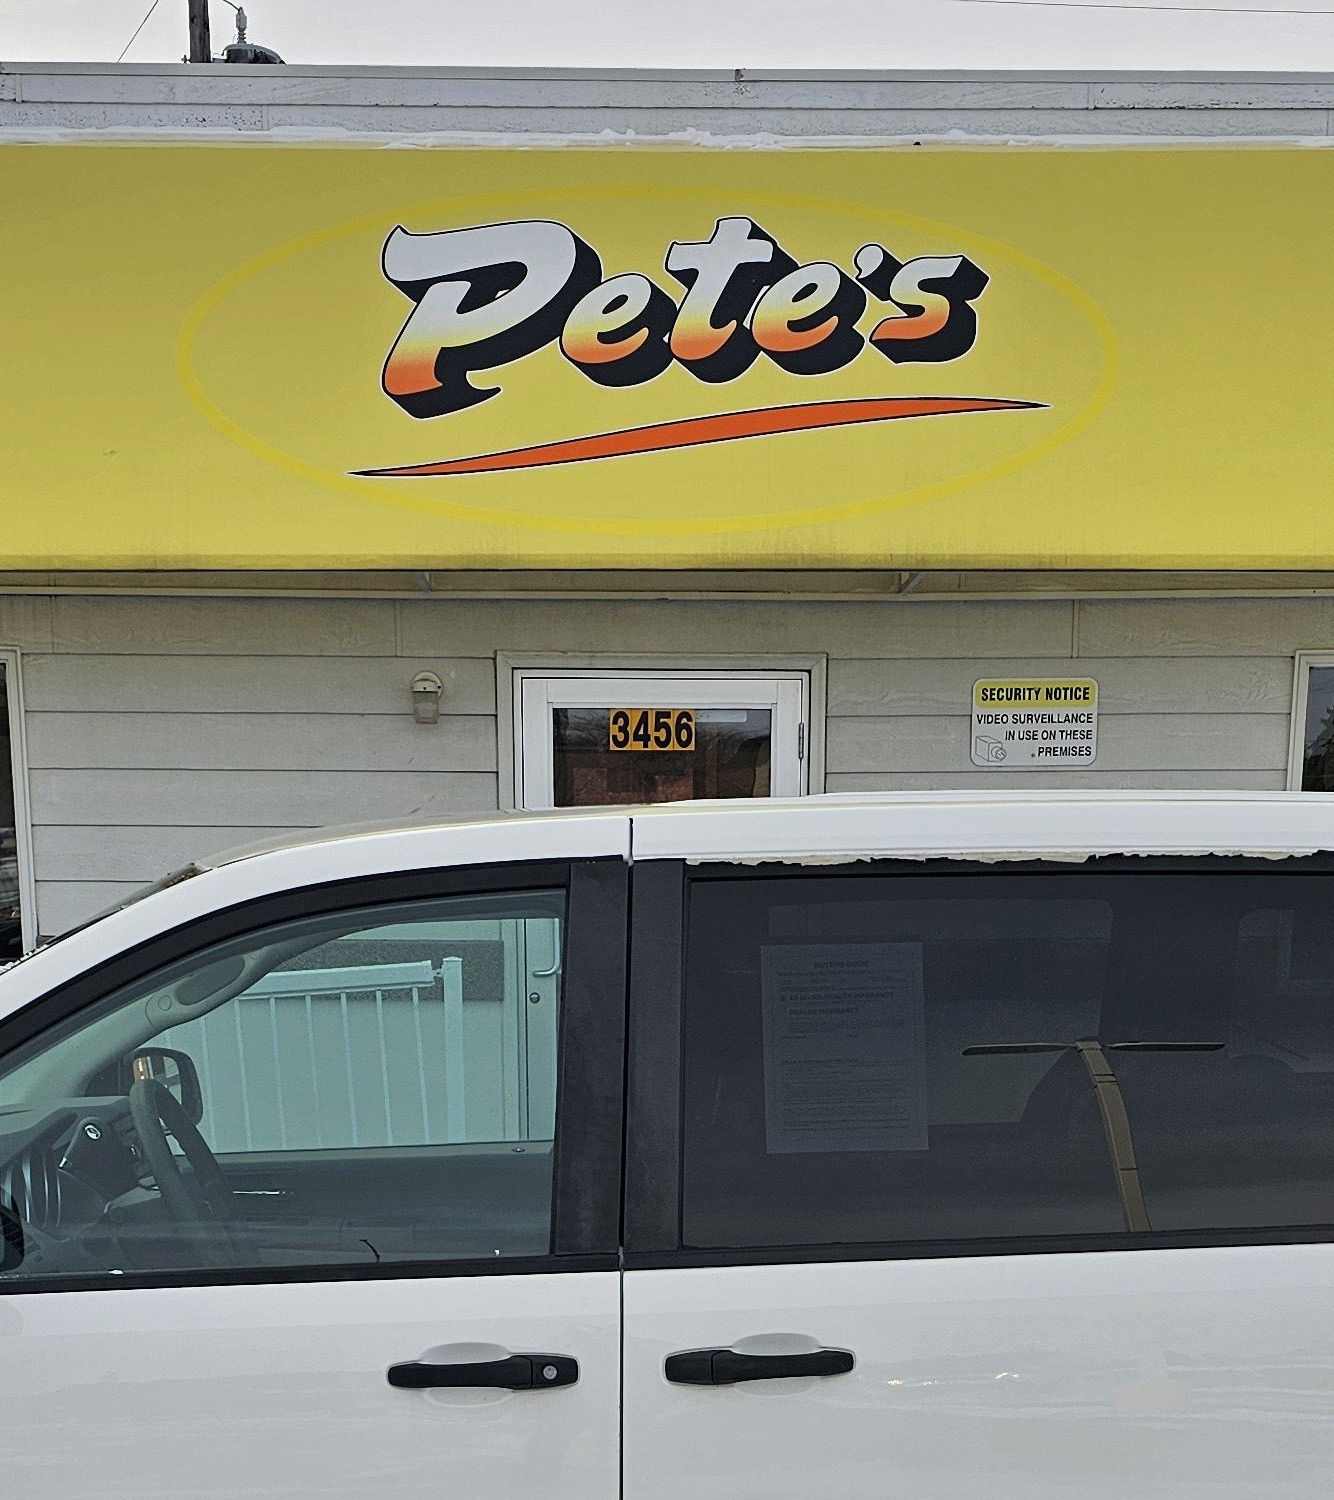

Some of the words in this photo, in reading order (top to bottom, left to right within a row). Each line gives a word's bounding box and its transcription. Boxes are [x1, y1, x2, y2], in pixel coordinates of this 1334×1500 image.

[381, 216, 989, 418] Pete's
[981, 687, 1041, 701] SECURITY
[1045, 687, 1090, 700] NOTICE
[977, 714, 1009, 724] VIDEO
[1012, 713, 1093, 724] SURVEILLANCE
[611, 710, 693, 749] 3456
[1005, 730, 1015, 740] IN
[1018, 730, 1038, 740] USE
[1041, 730, 1056, 740] ON
[1059, 729, 1092, 740] THESE
[1038, 746, 1092, 757] PREMISES
